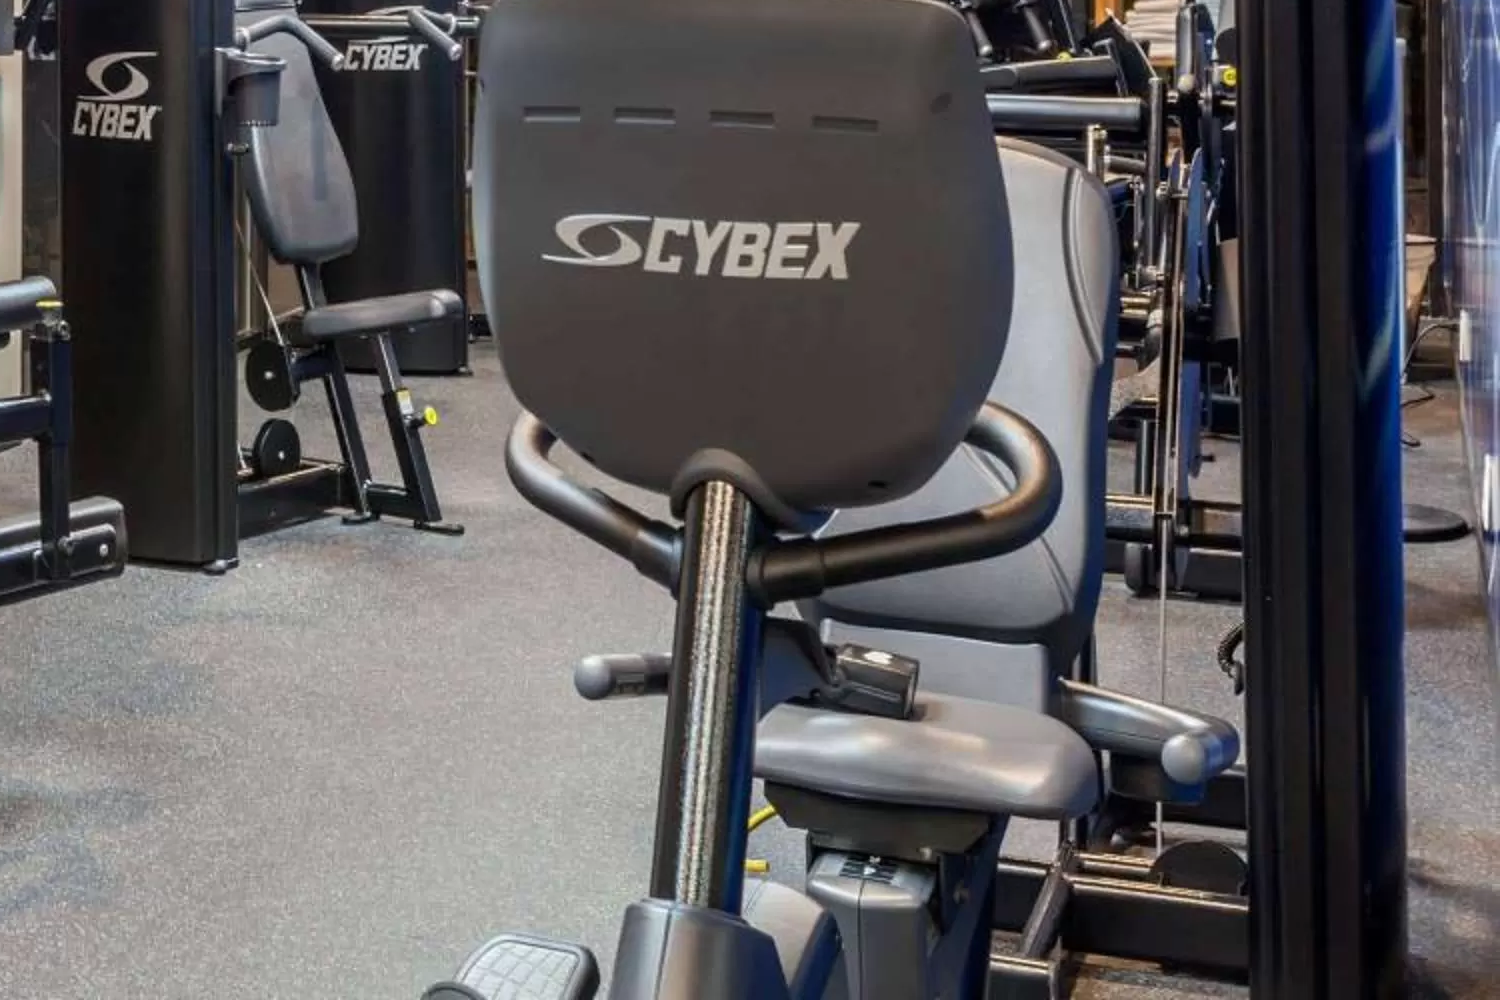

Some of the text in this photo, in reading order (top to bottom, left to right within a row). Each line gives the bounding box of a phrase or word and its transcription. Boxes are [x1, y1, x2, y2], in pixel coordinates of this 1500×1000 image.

[344, 43, 424, 71] CYBEX
[73, 101, 157, 141] CYBEX
[643, 217, 861, 280] CYBEX
